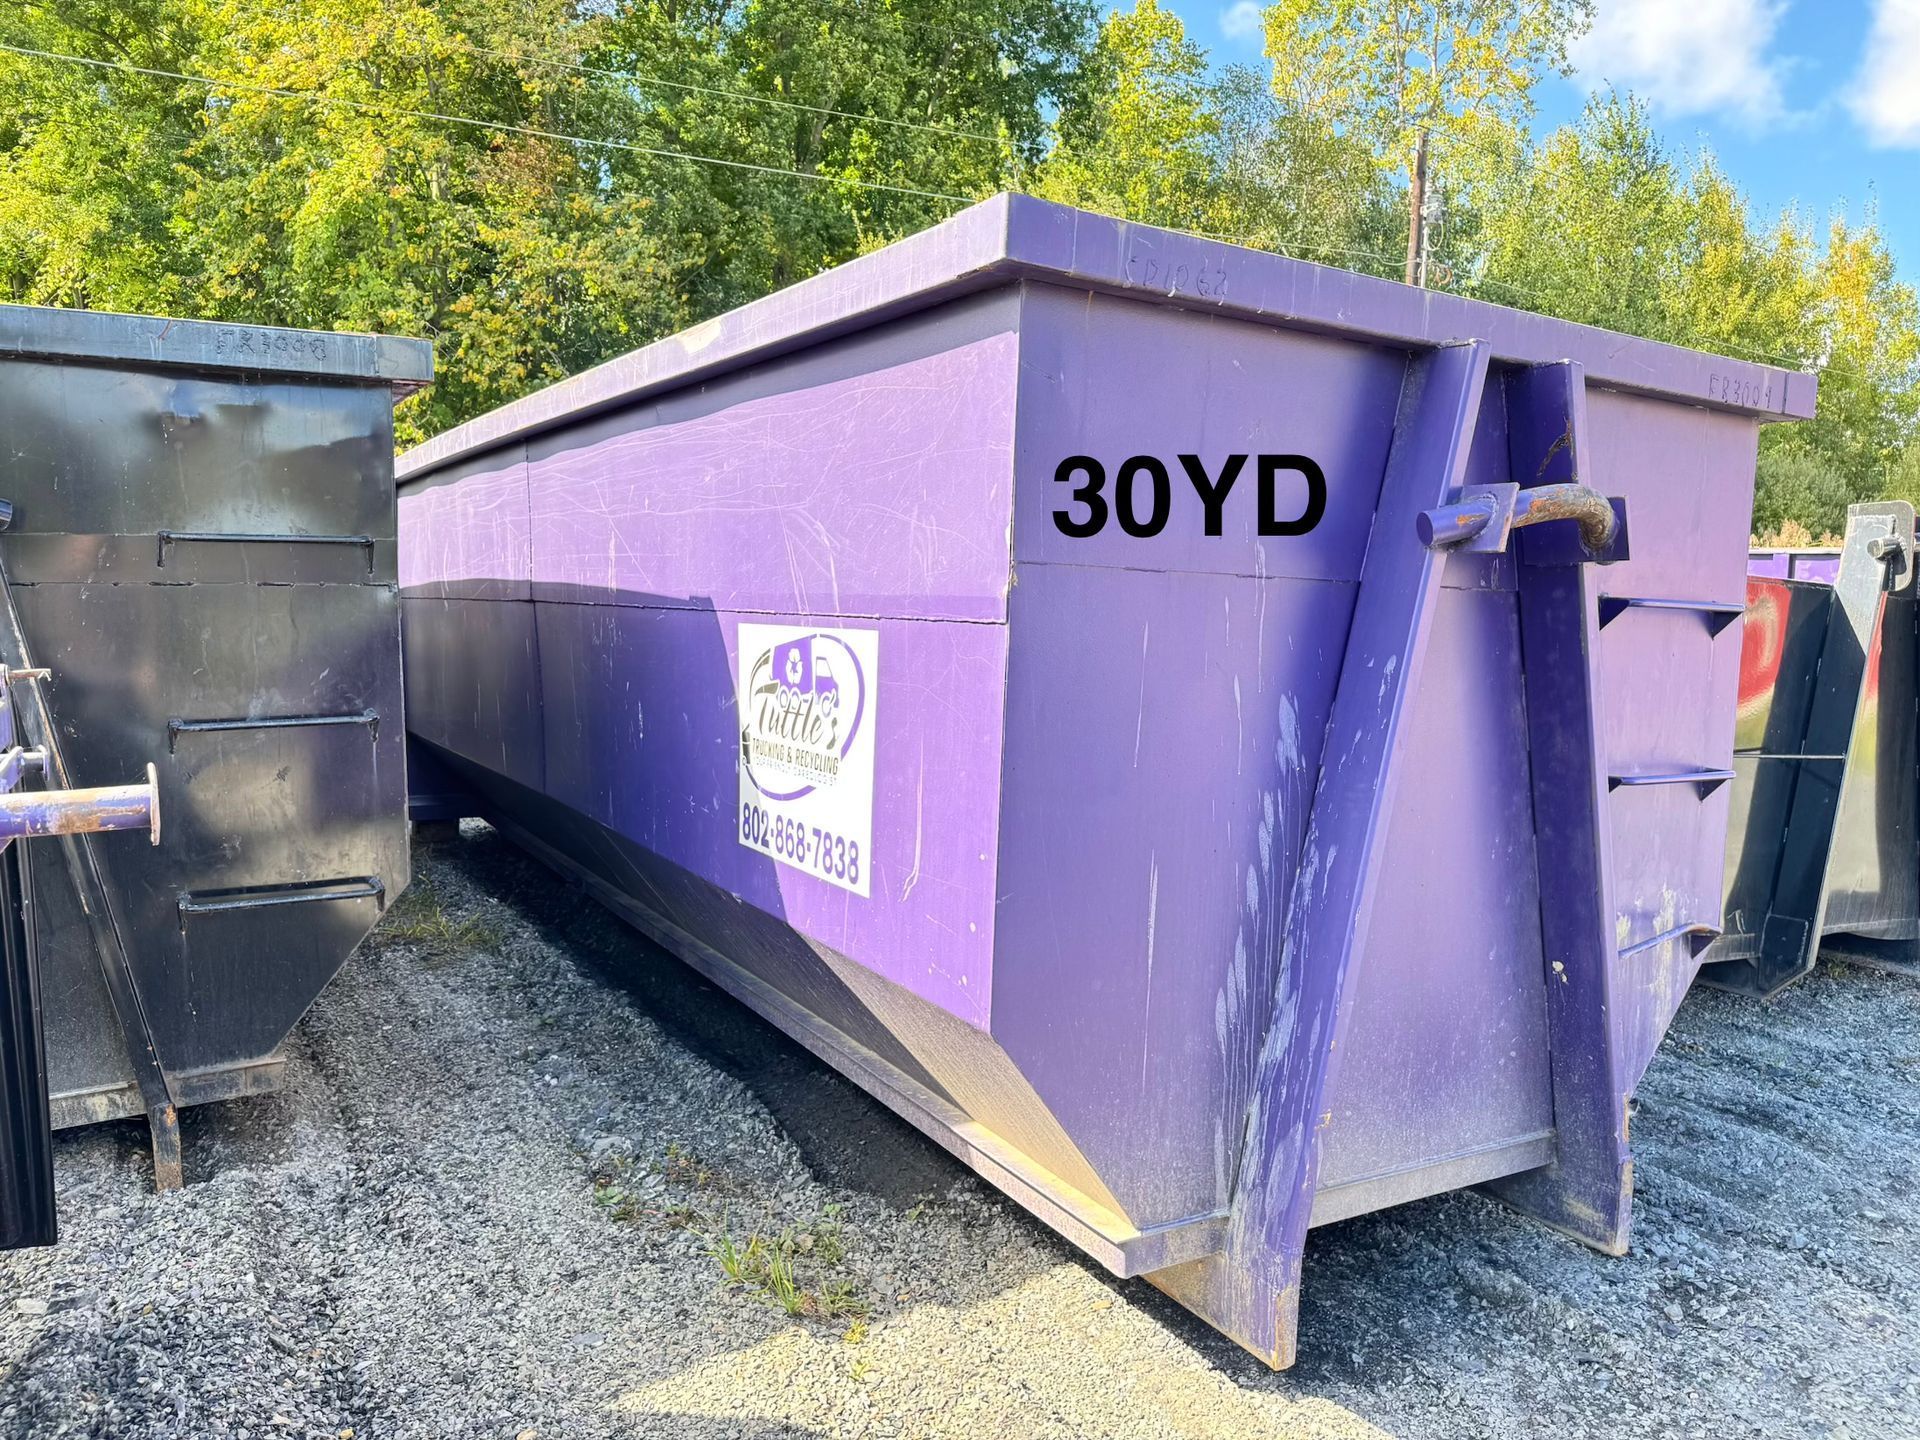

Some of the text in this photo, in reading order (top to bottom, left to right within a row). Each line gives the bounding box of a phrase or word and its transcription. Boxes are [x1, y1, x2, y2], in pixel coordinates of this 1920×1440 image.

[755, 684, 838, 751] Tuttle's
[753, 737, 785, 763] TRUCKING
[786, 746, 793, 764] &
[795, 747, 839, 776] RECYCLING
[742, 802, 859, 885] 802-868-7838
